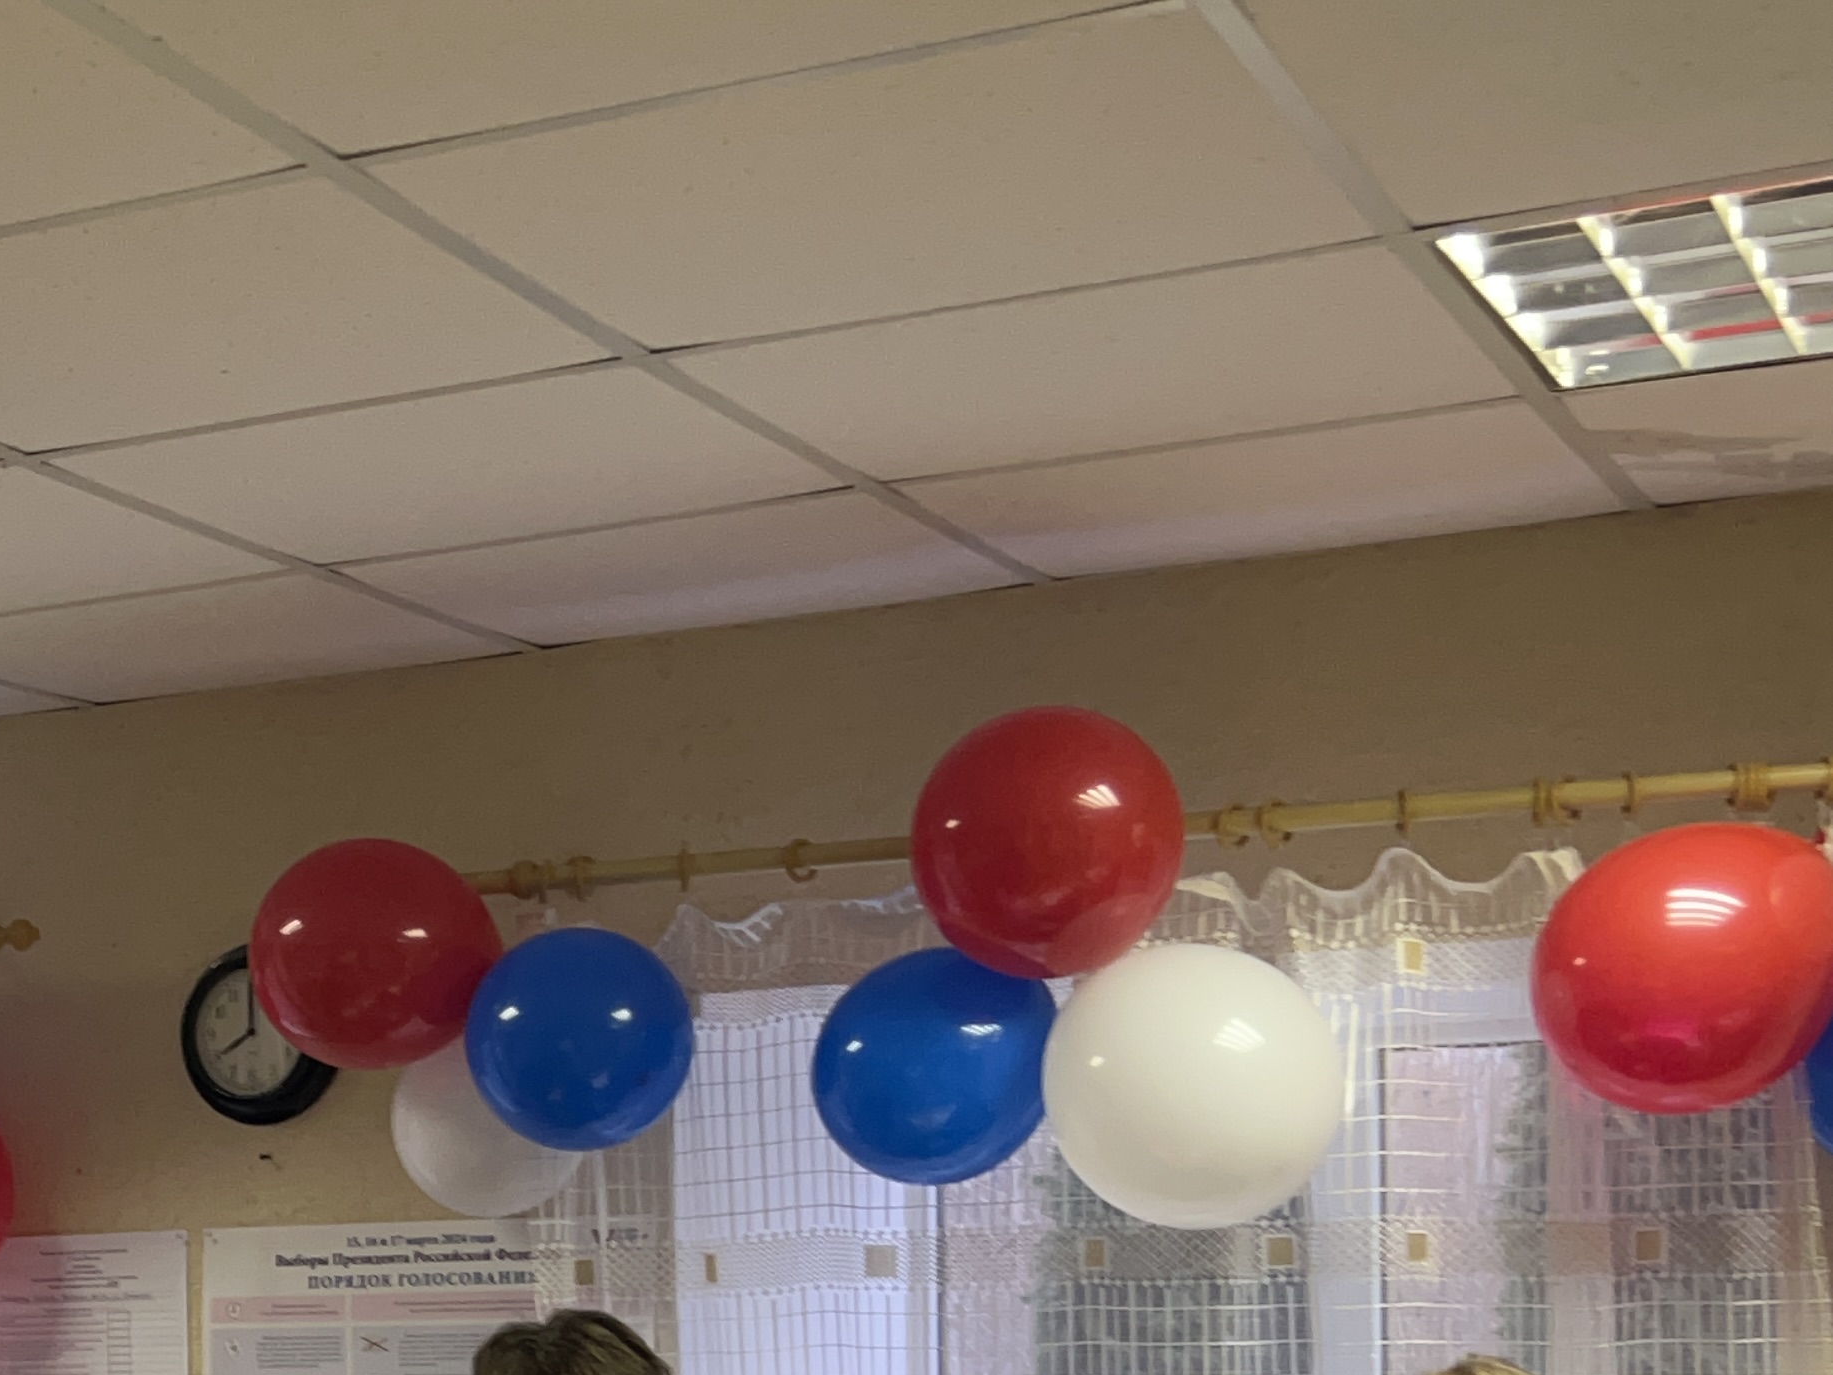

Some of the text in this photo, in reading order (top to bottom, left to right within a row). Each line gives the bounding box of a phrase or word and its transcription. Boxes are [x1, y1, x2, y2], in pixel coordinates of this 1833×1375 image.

[275, 1254, 329, 1269] Выборы
[332, 1252, 410, 1268] Президента
[414, 1248, 491, 1263] Российской
[308, 1274, 392, 1290] ПОРЯДОК
